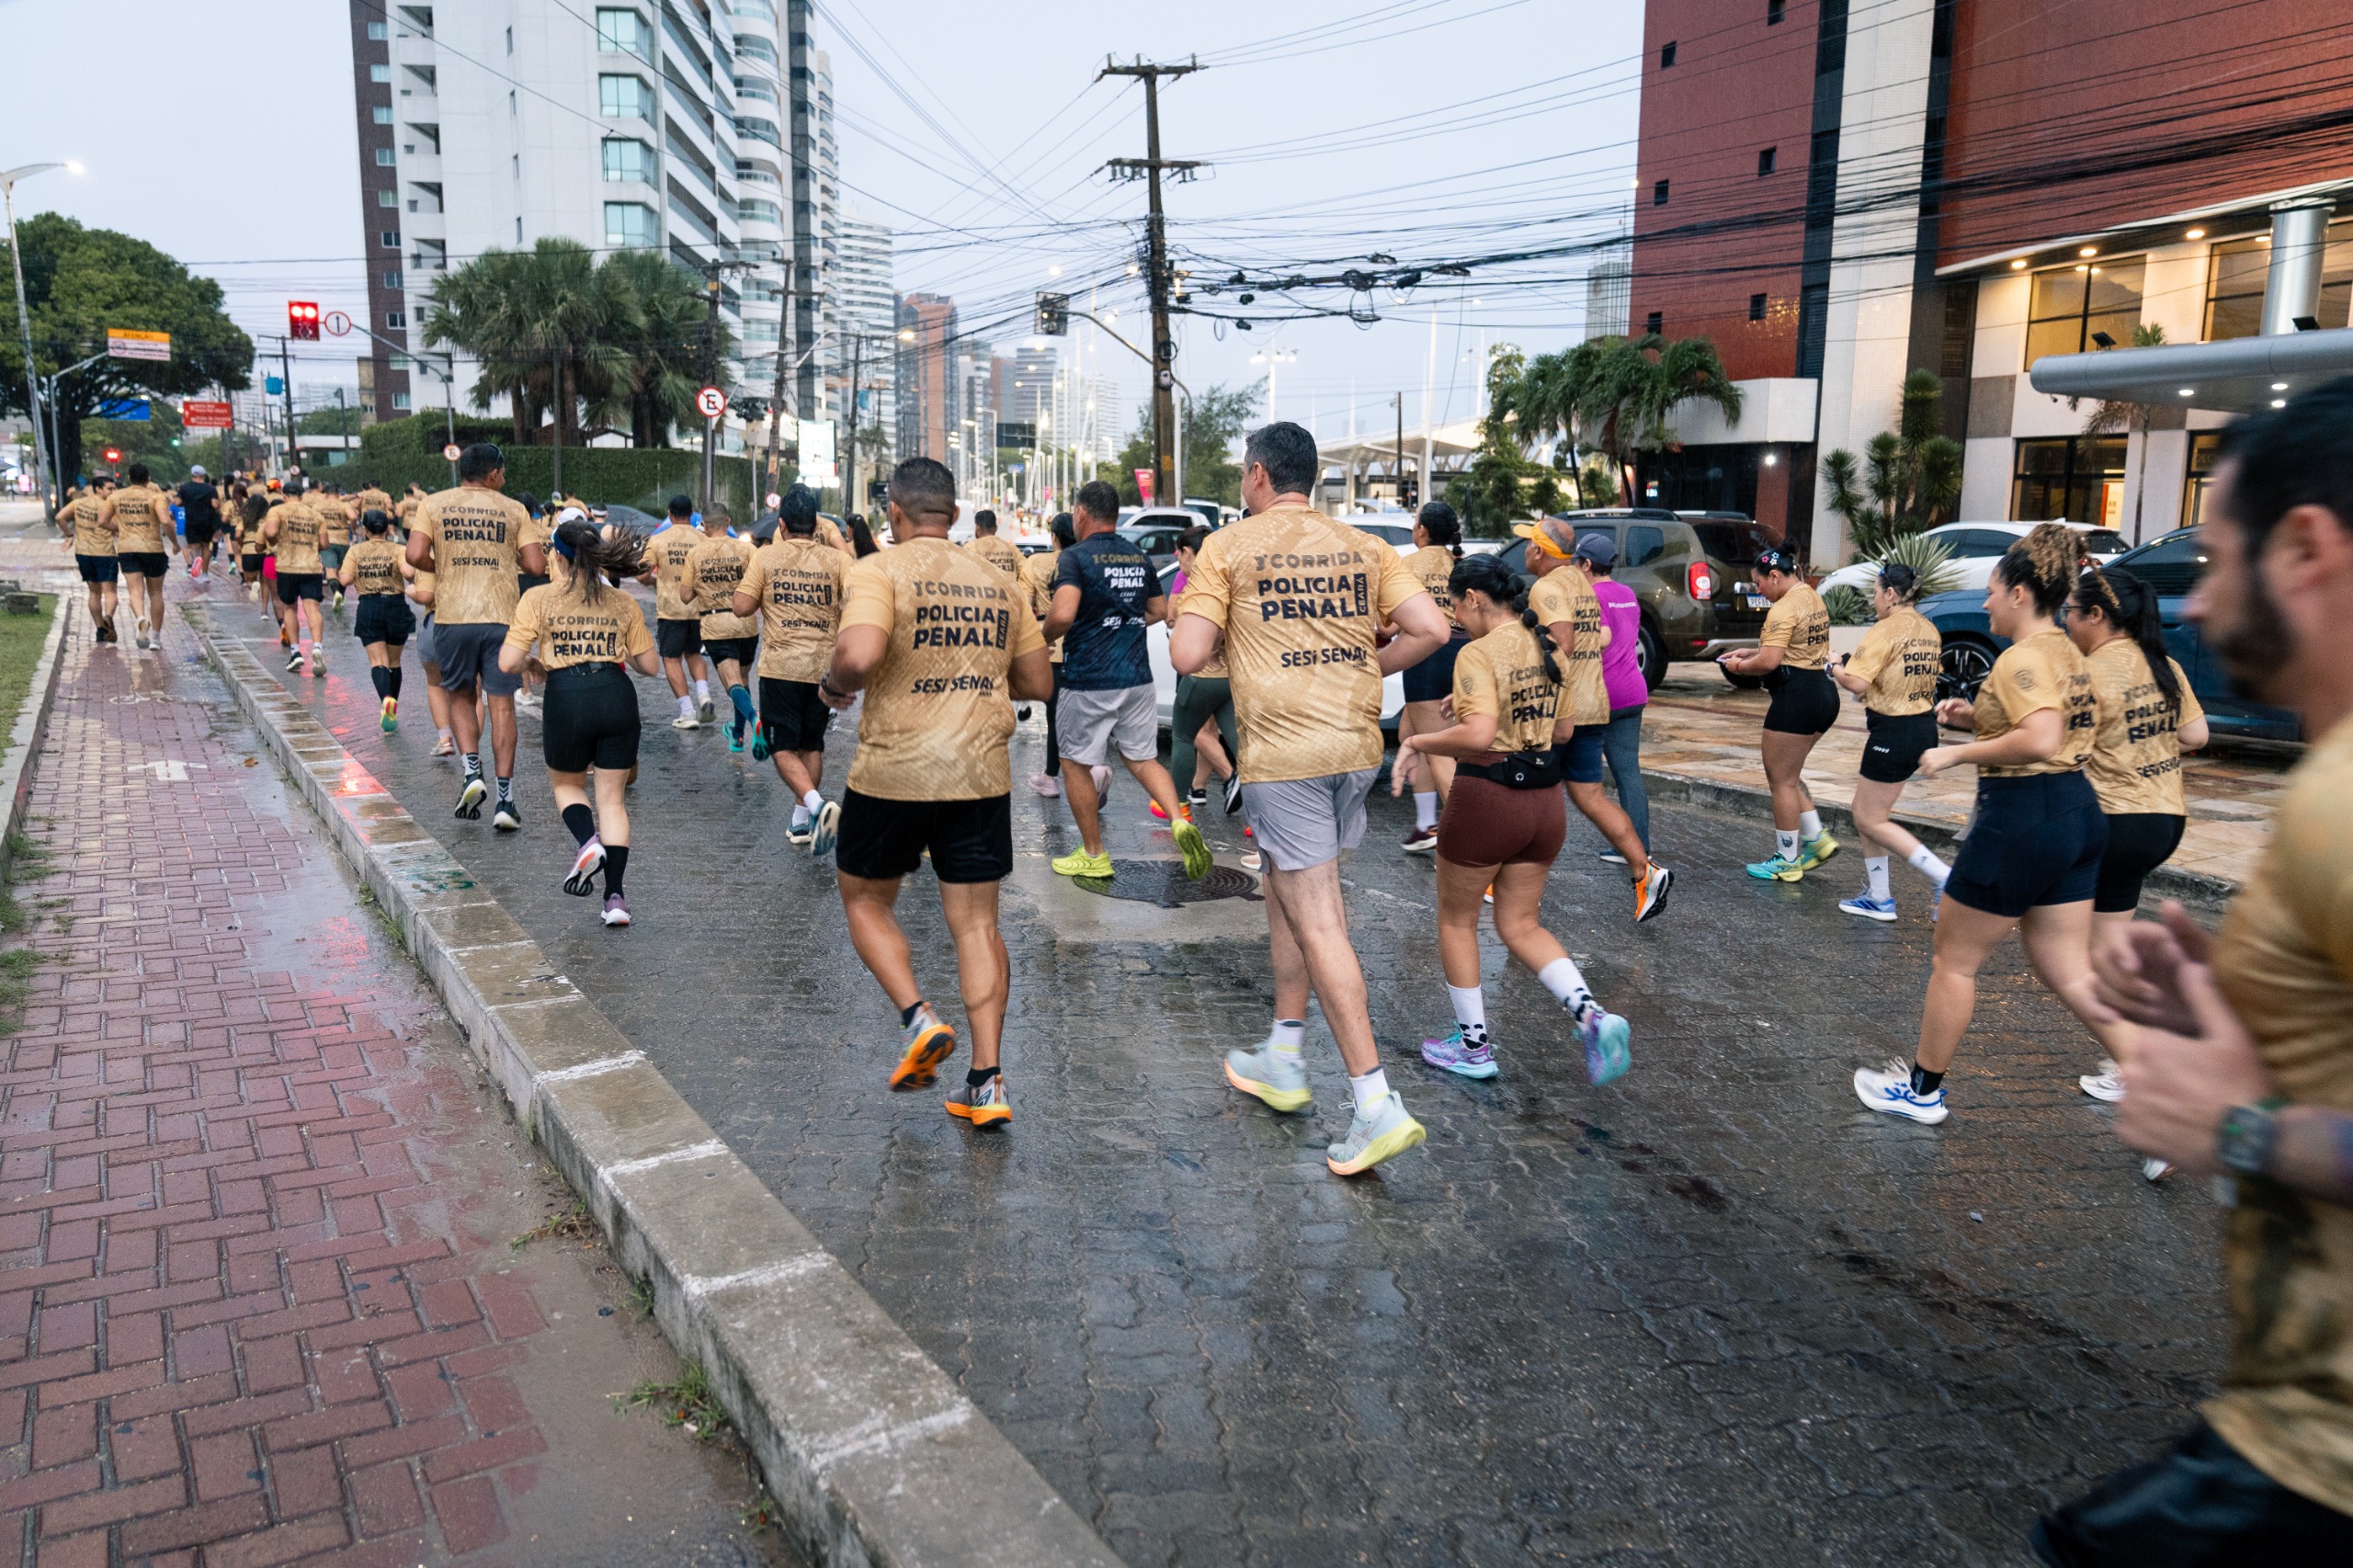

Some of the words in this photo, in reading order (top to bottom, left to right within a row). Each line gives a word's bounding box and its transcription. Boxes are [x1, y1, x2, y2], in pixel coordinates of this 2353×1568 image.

[449, 506, 506, 517] CORRIDA
[445, 529, 495, 541] PENAL
[1270, 551, 1365, 569] CORRIDA
[702, 574, 736, 583] PENAL
[781, 569, 831, 580] CORRIDA
[1110, 577, 1144, 588] PENAL
[925, 581, 1008, 602] CORRIDA
[774, 593, 825, 606] PENAL
[1261, 597, 1356, 622] PENAL
[557, 616, 618, 627] CORRIDA
[913, 627, 995, 650] PENAL
[553, 644, 607, 657] PENAL
